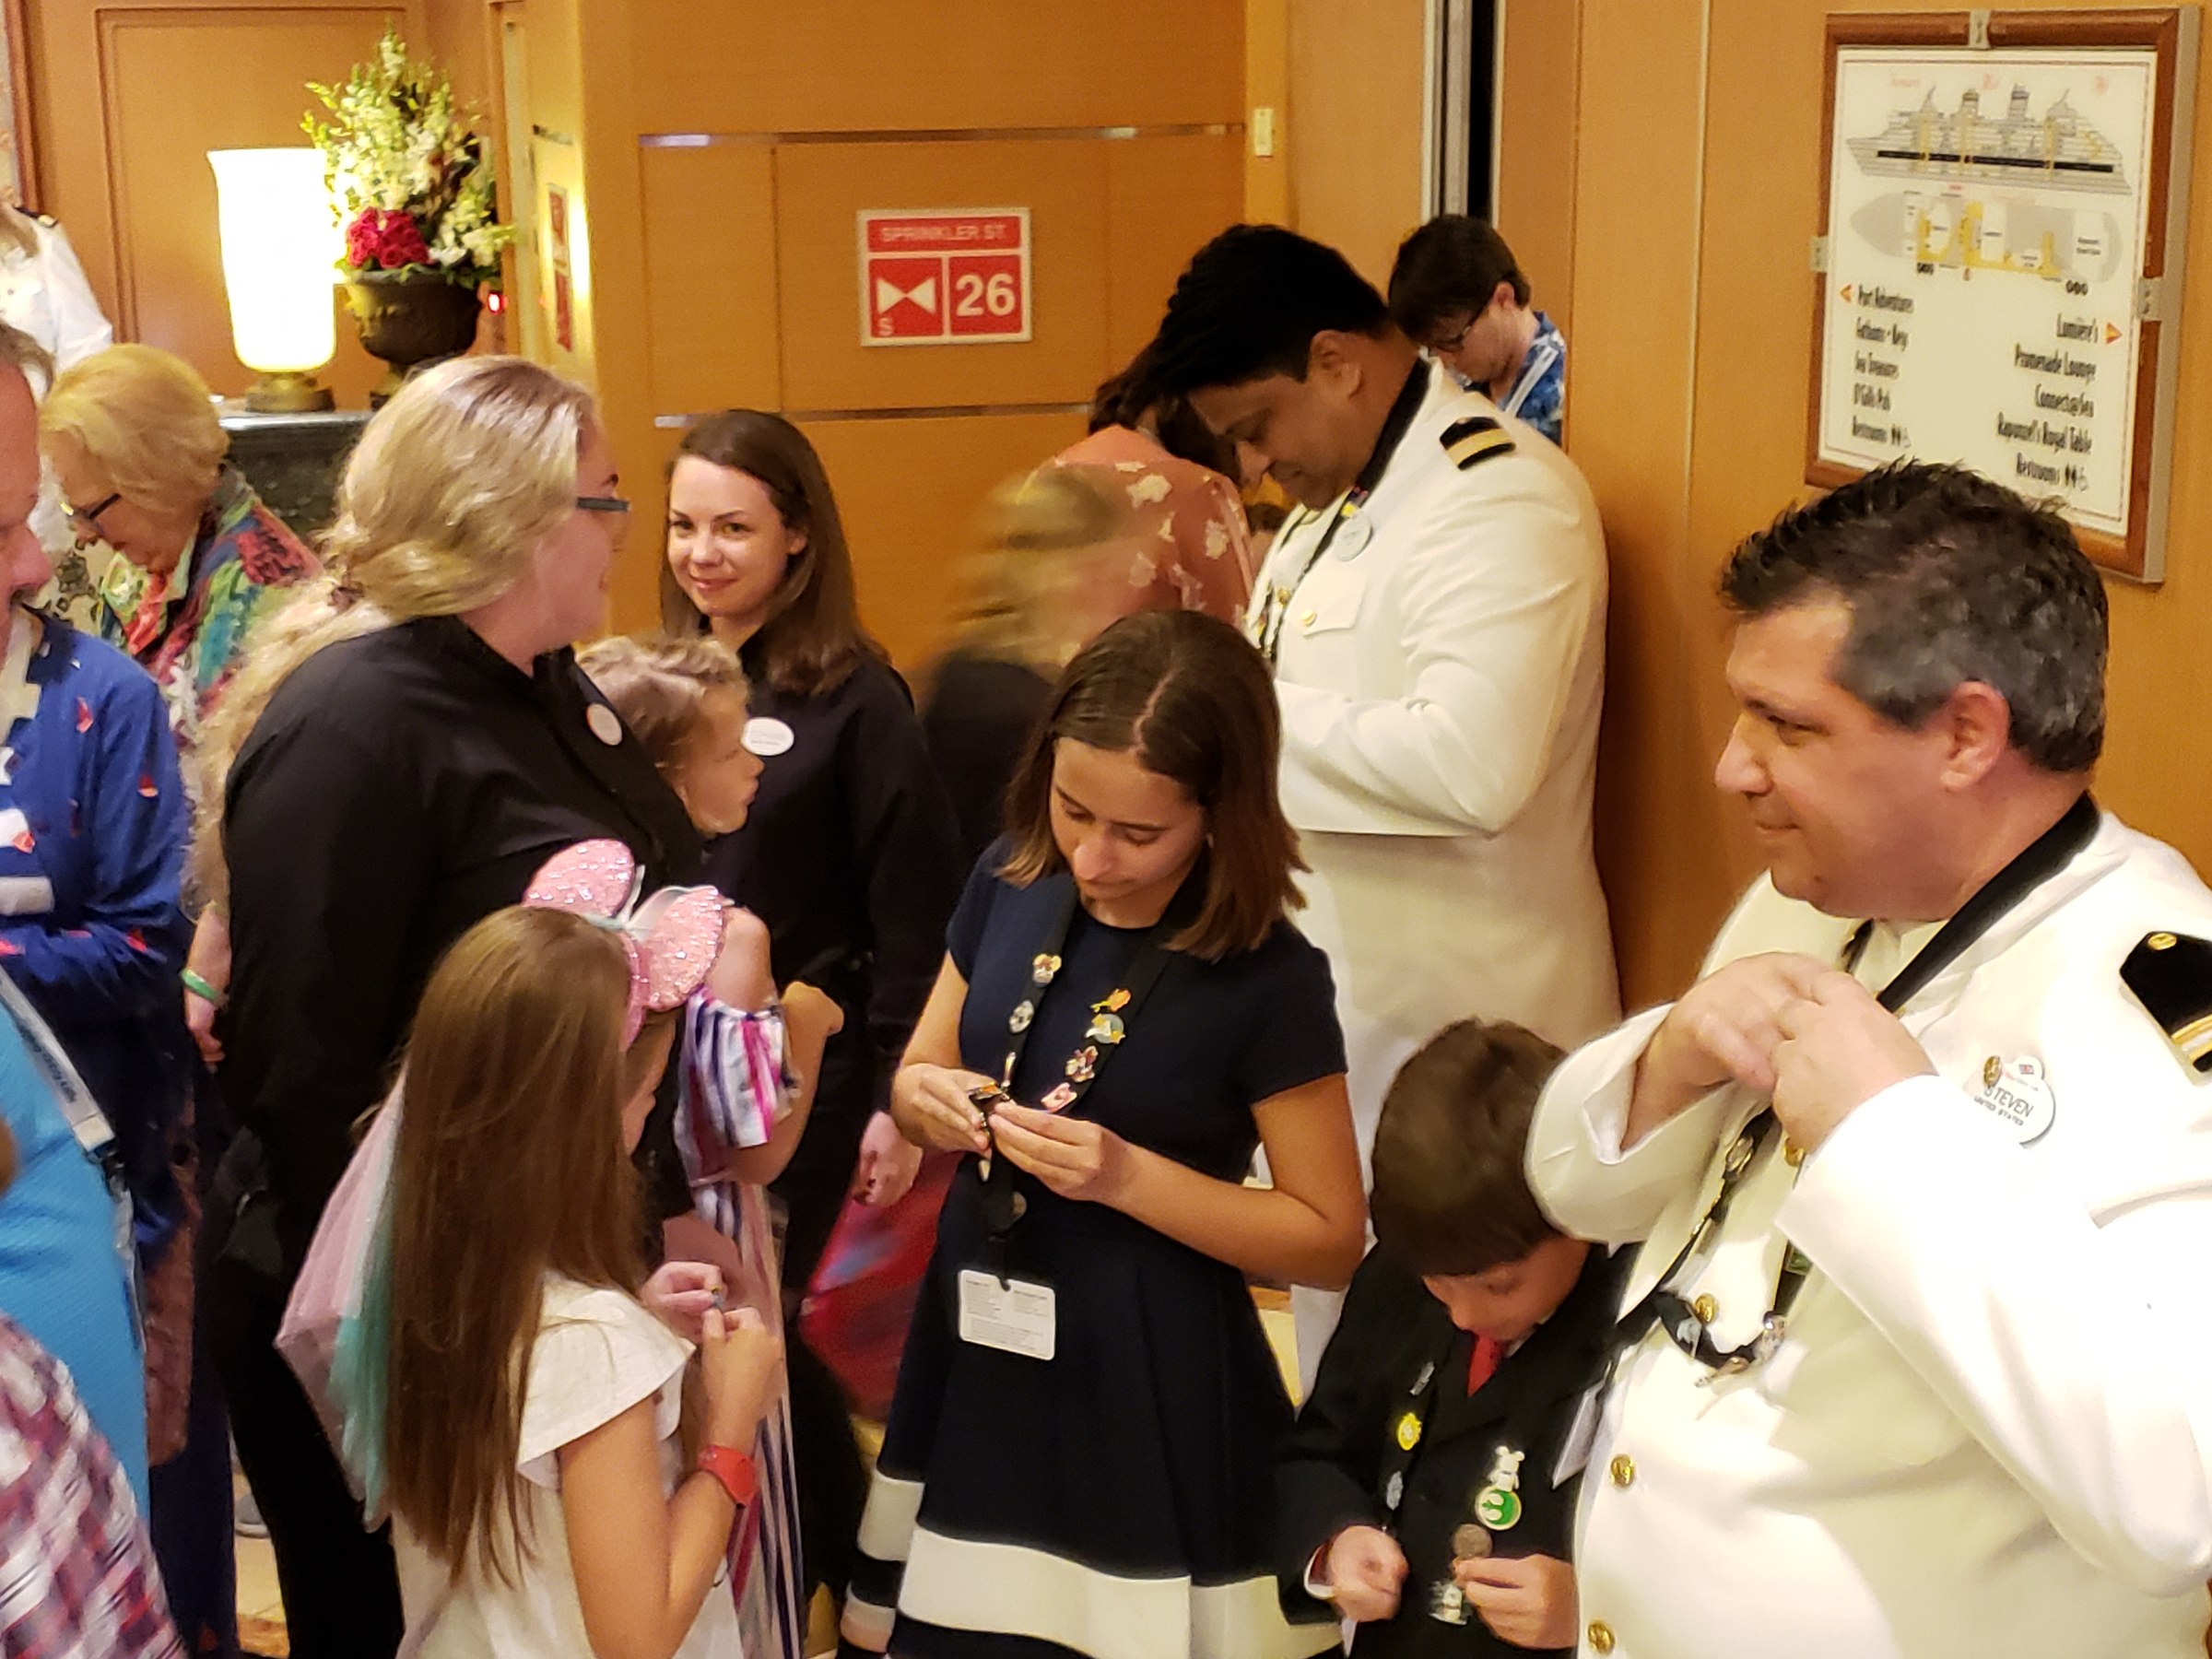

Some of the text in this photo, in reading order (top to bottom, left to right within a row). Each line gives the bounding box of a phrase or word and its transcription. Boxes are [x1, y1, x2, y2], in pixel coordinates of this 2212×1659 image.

[956, 273, 1015, 316] 26
[878, 317, 893, 335] S
[1983, 1086, 2034, 1118] STEVEN
